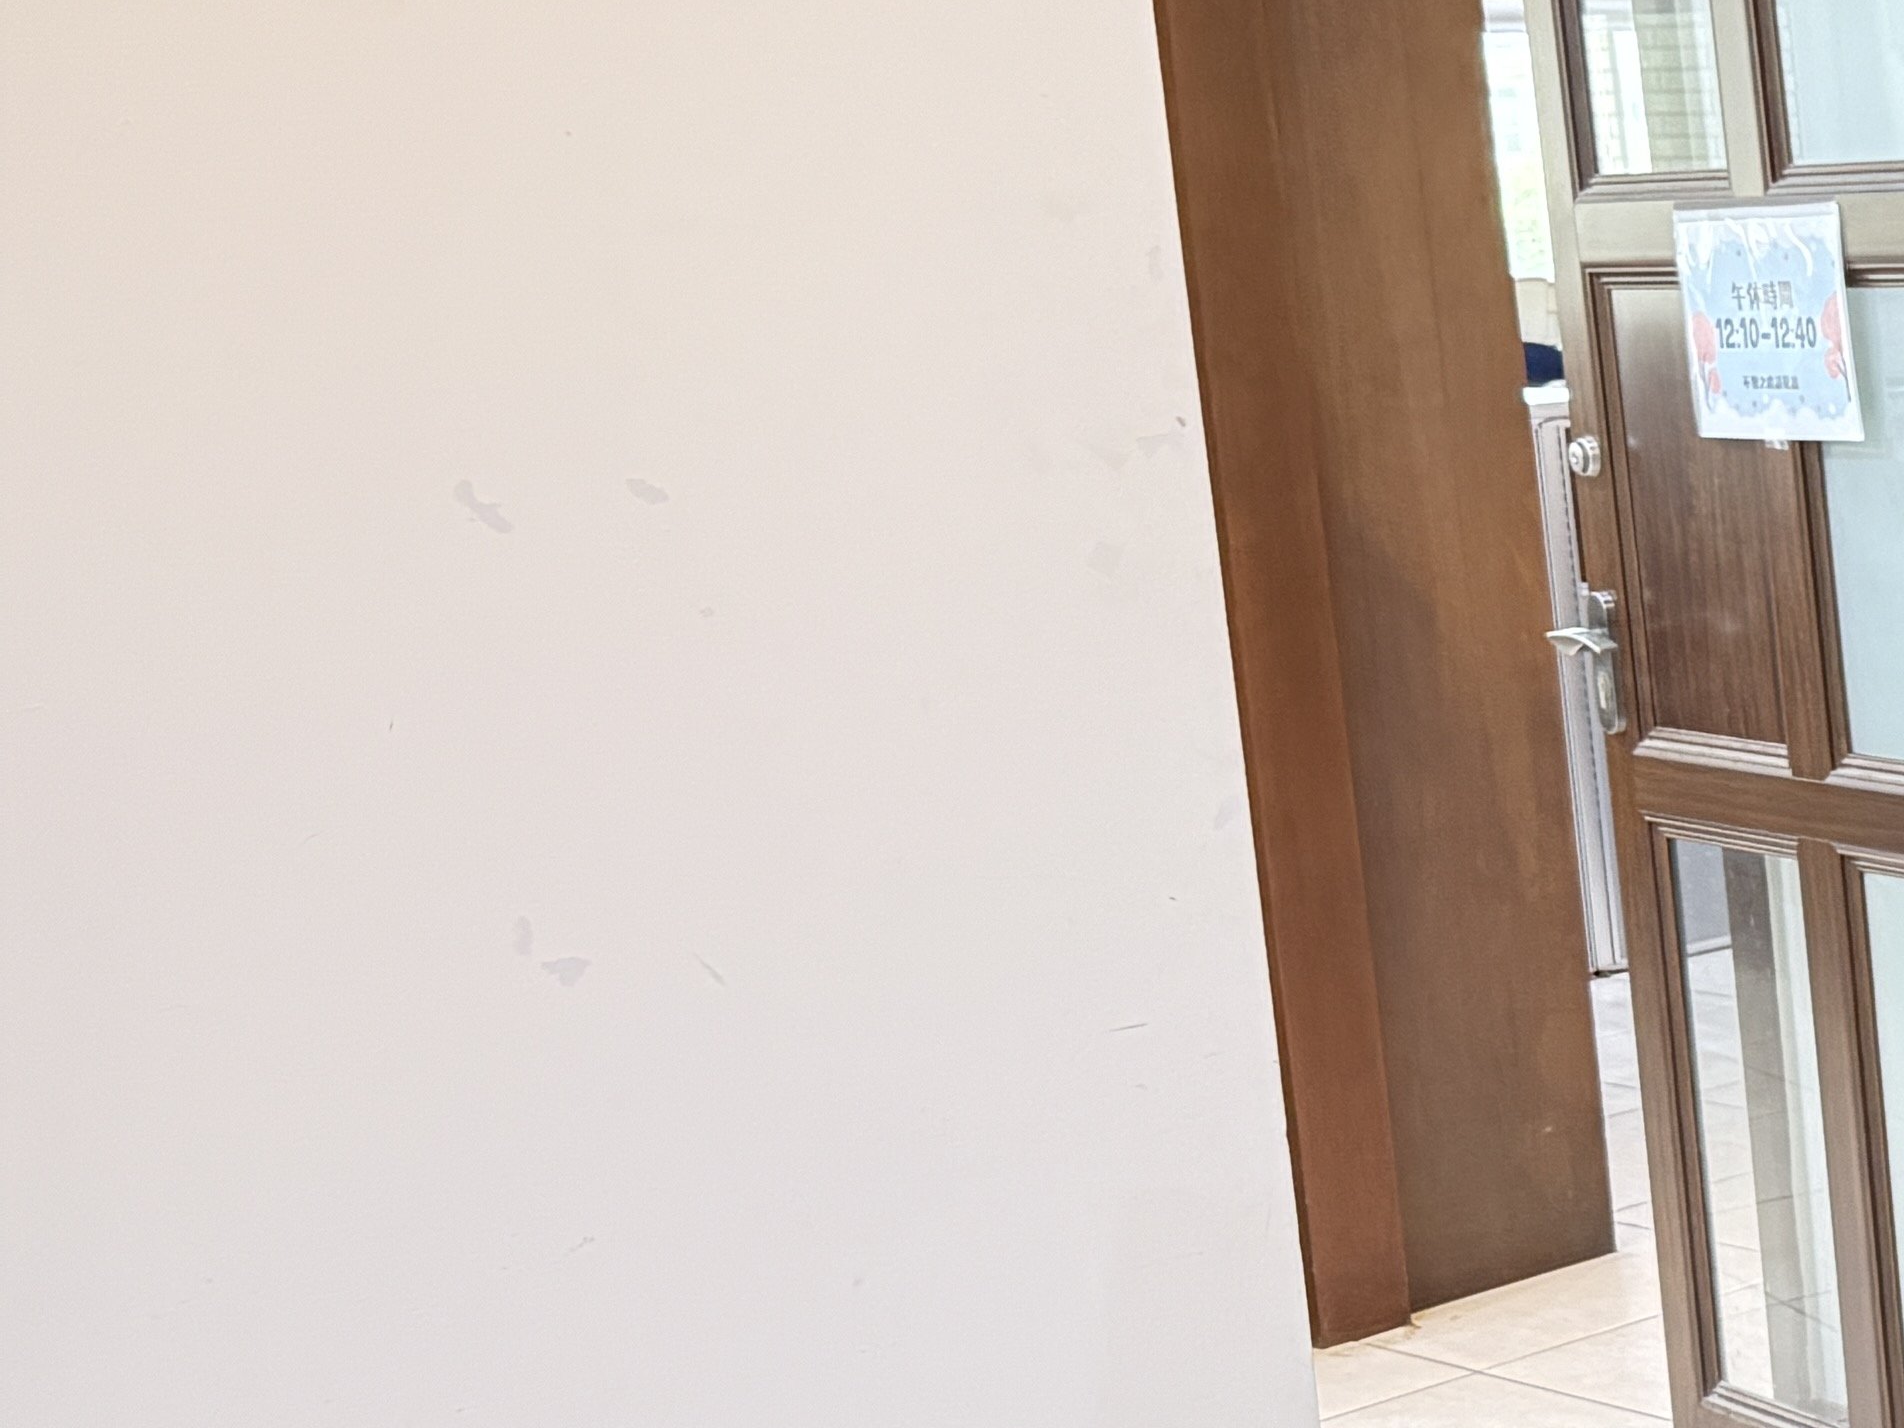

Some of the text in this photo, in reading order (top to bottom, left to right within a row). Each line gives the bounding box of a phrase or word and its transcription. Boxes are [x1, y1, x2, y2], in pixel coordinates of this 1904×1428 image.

[1731, 280, 1794, 311] 午休時間
[1715, 316, 1817, 350] 12:10-12:40
